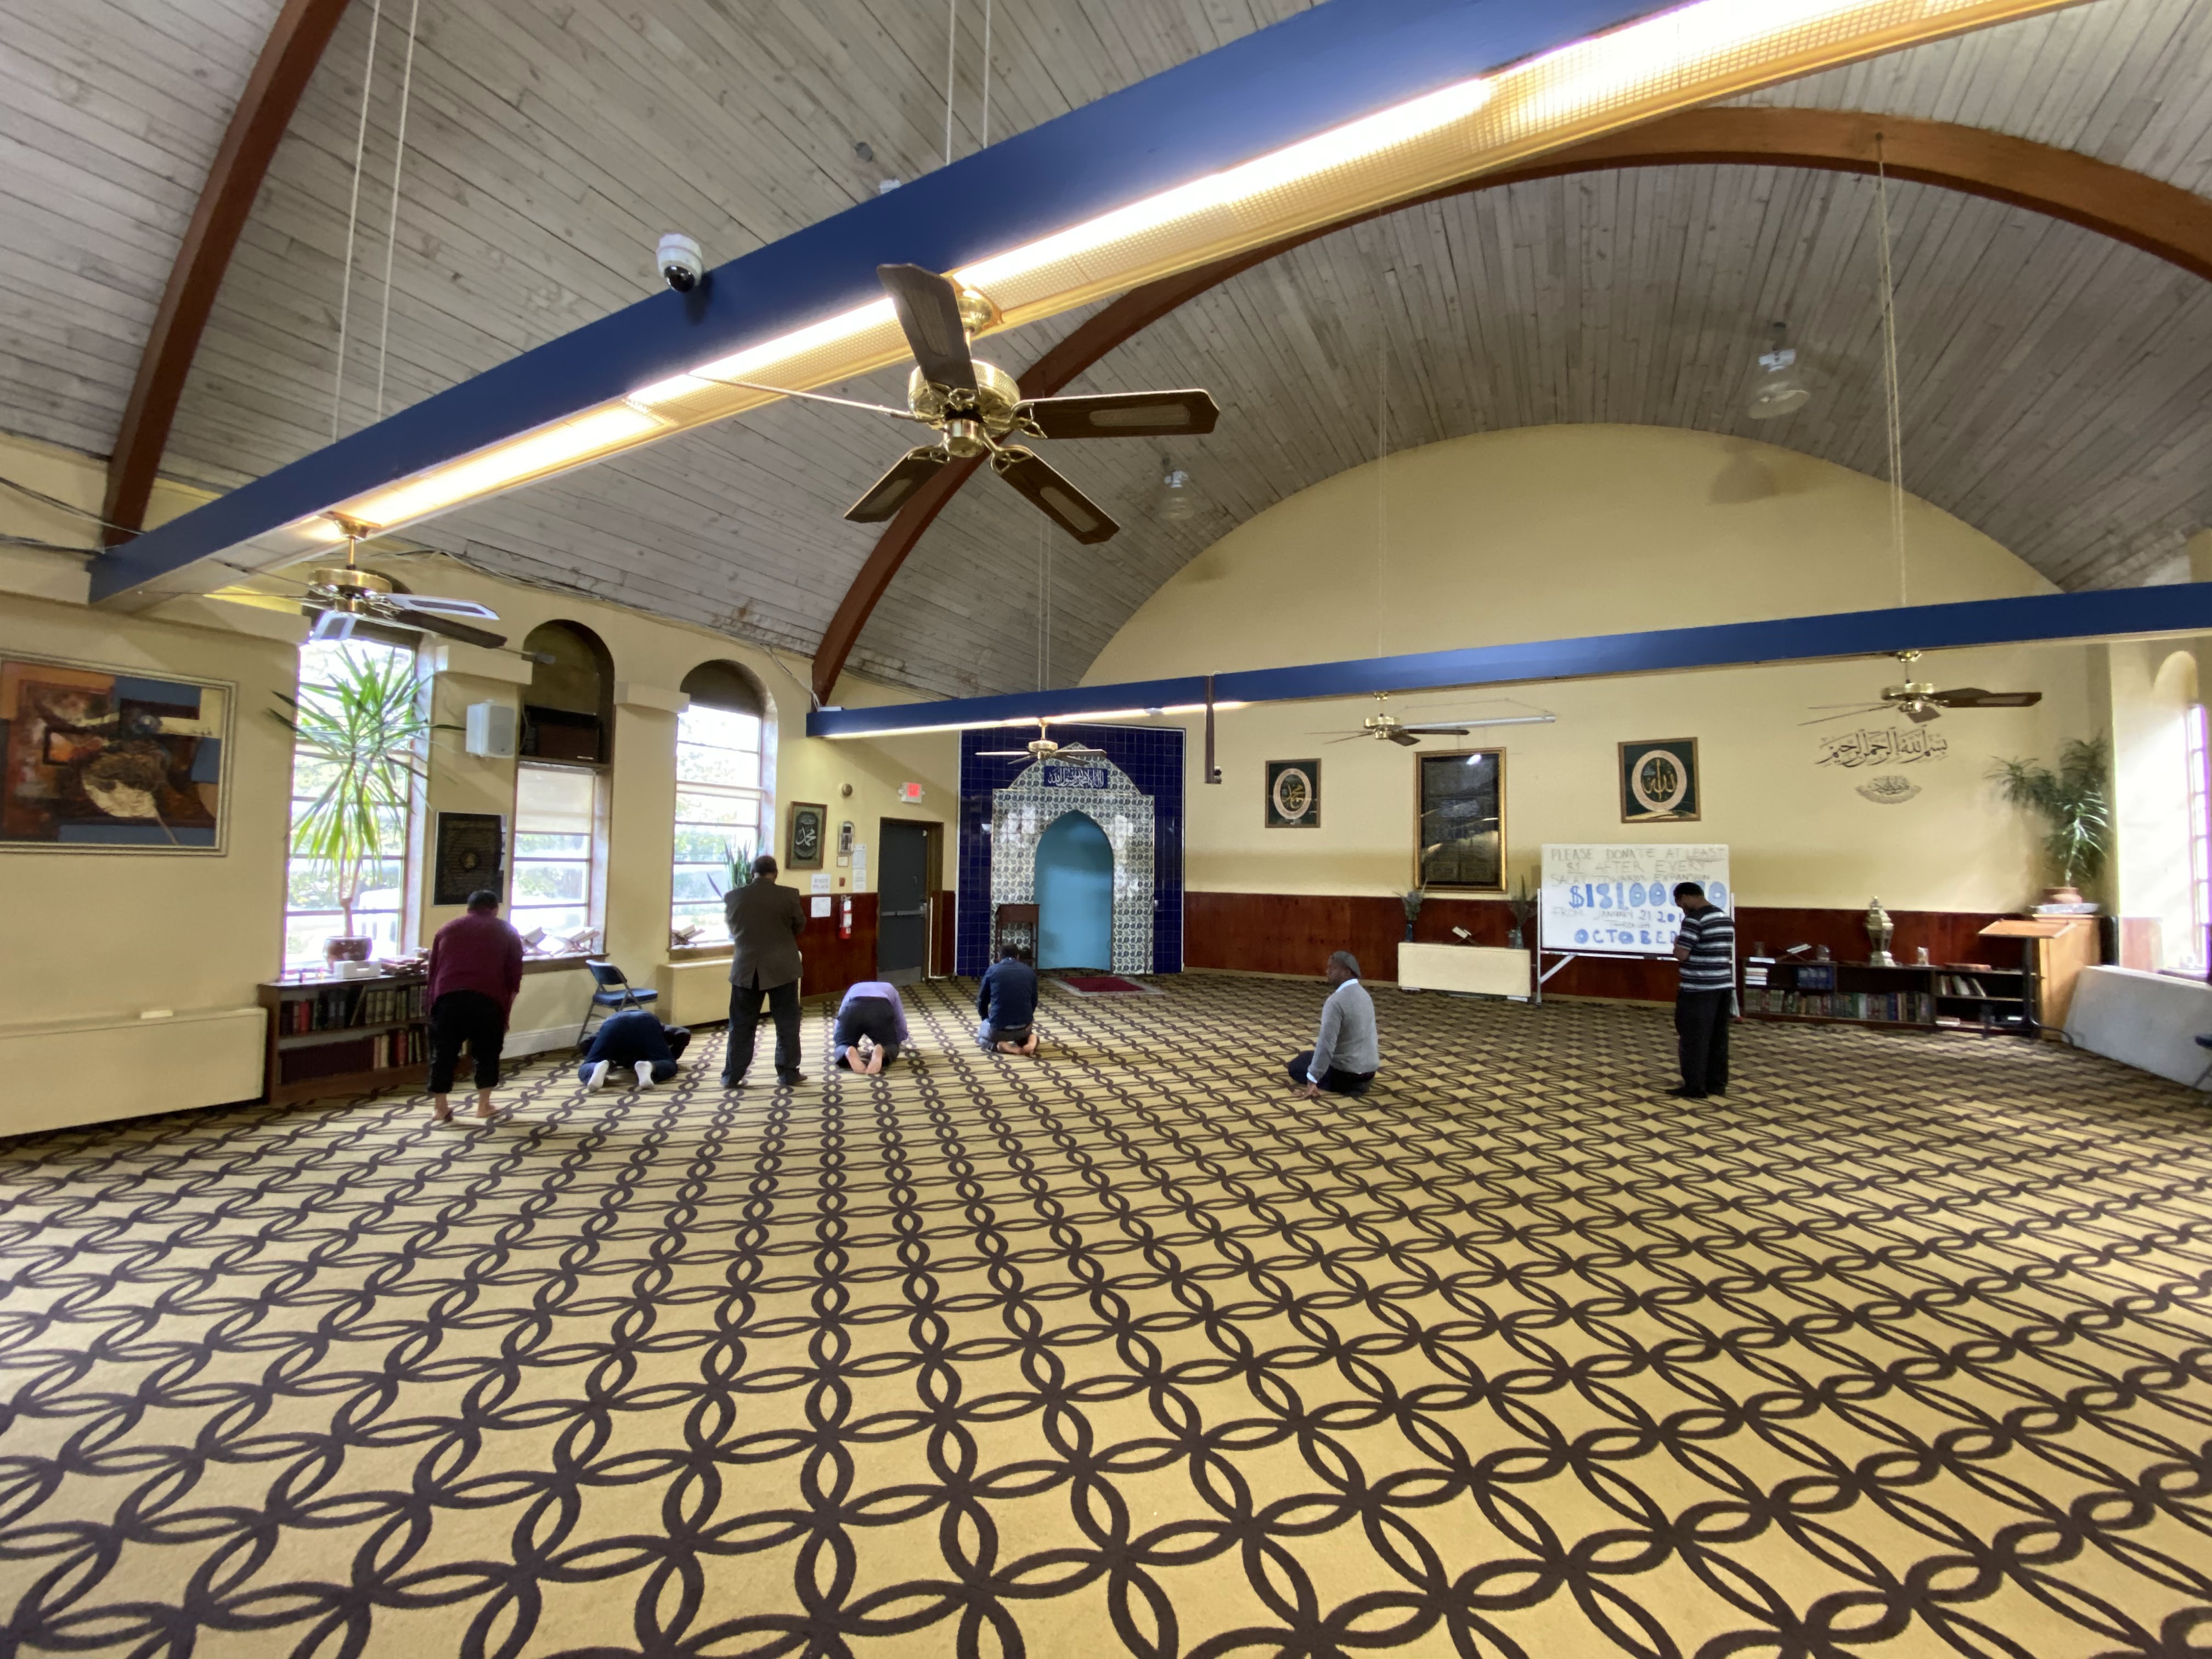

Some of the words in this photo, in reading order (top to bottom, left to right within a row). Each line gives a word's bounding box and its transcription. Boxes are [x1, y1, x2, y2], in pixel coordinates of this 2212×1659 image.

[1551, 849, 1593, 861] PLEASE
[1606, 848, 1655, 860] DONATE
[1666, 848, 1681, 859] AT
[1686, 848, 1725, 859] LEAST
[1655, 860, 1705, 873] EVERY
[1654, 873, 1711, 882] EXPANSION
[1593, 910, 1634, 920] JANUARY
